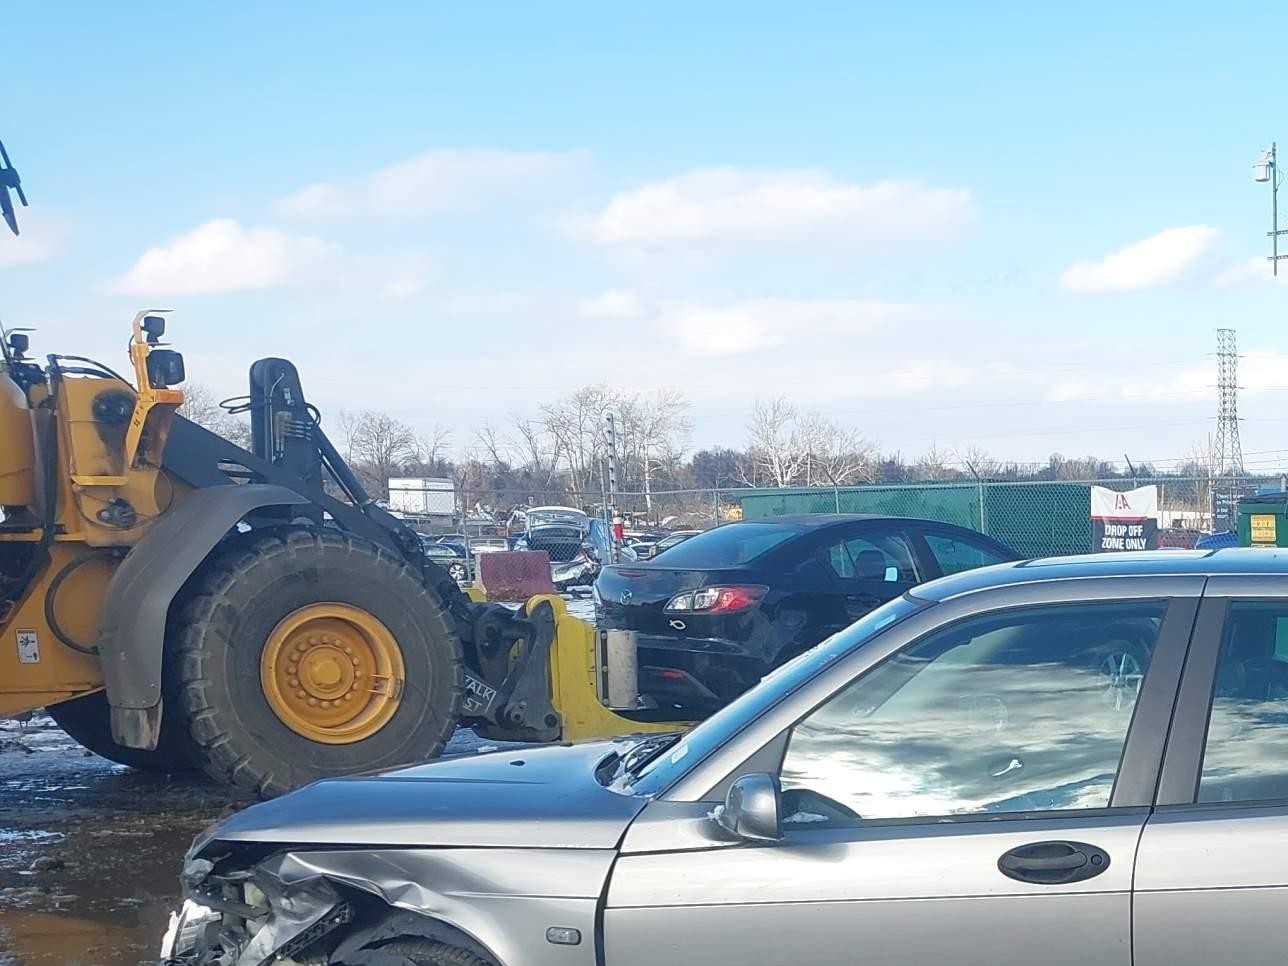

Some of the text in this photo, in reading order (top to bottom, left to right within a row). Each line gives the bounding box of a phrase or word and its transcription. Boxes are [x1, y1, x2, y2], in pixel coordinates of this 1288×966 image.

[1104, 524, 1143, 537] DROP OFF
[1101, 537, 1147, 549] ZONE ONLY
